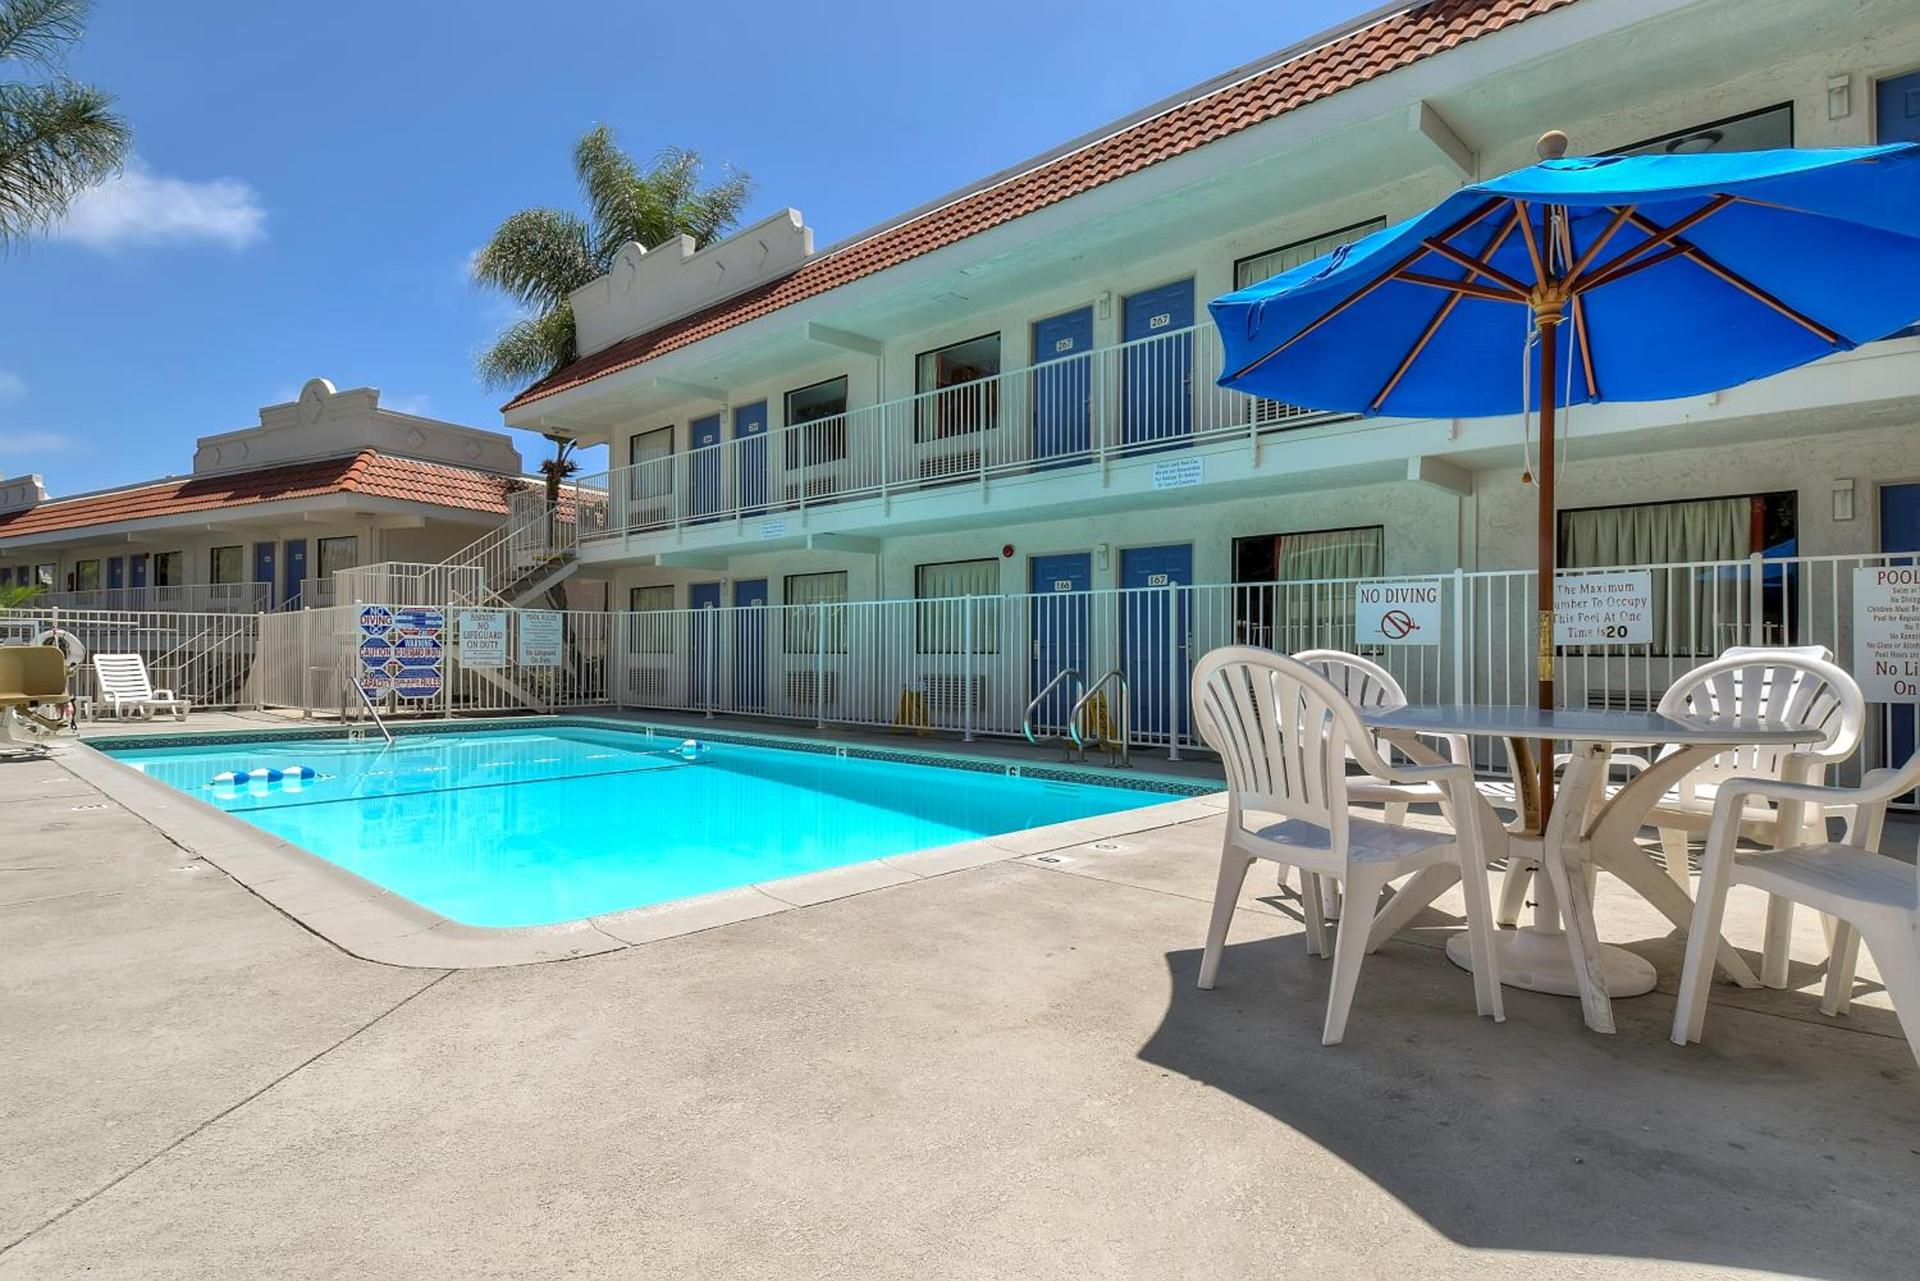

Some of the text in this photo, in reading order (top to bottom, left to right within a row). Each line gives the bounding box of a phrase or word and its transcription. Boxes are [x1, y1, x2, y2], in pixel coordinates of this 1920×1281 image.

[1149, 575, 1167, 586] 167
[1877, 570, 1920, 585] POOL
[1557, 583, 1634, 595] The Maximum
[1361, 588, 1437, 604] NO DIVING
[1553, 596, 1648, 610] umber To Occupy
[369, 607, 384, 615] NO
[1578, 612, 1600, 623] Pool
[1604, 612, 1616, 623] At
[1620, 610, 1642, 621] One
[360, 616, 393, 625] DIVING
[477, 622, 489, 630] NO
[463, 631, 503, 639] LIFEGUARD
[1568, 627, 1593, 638] Time
[1606, 625, 1628, 638] 20
[467, 641, 498, 649] ON DUTY
[360, 648, 391, 657] CAUTION
[1876, 661, 1898, 676] No
[1893, 680, 1917, 695] On
